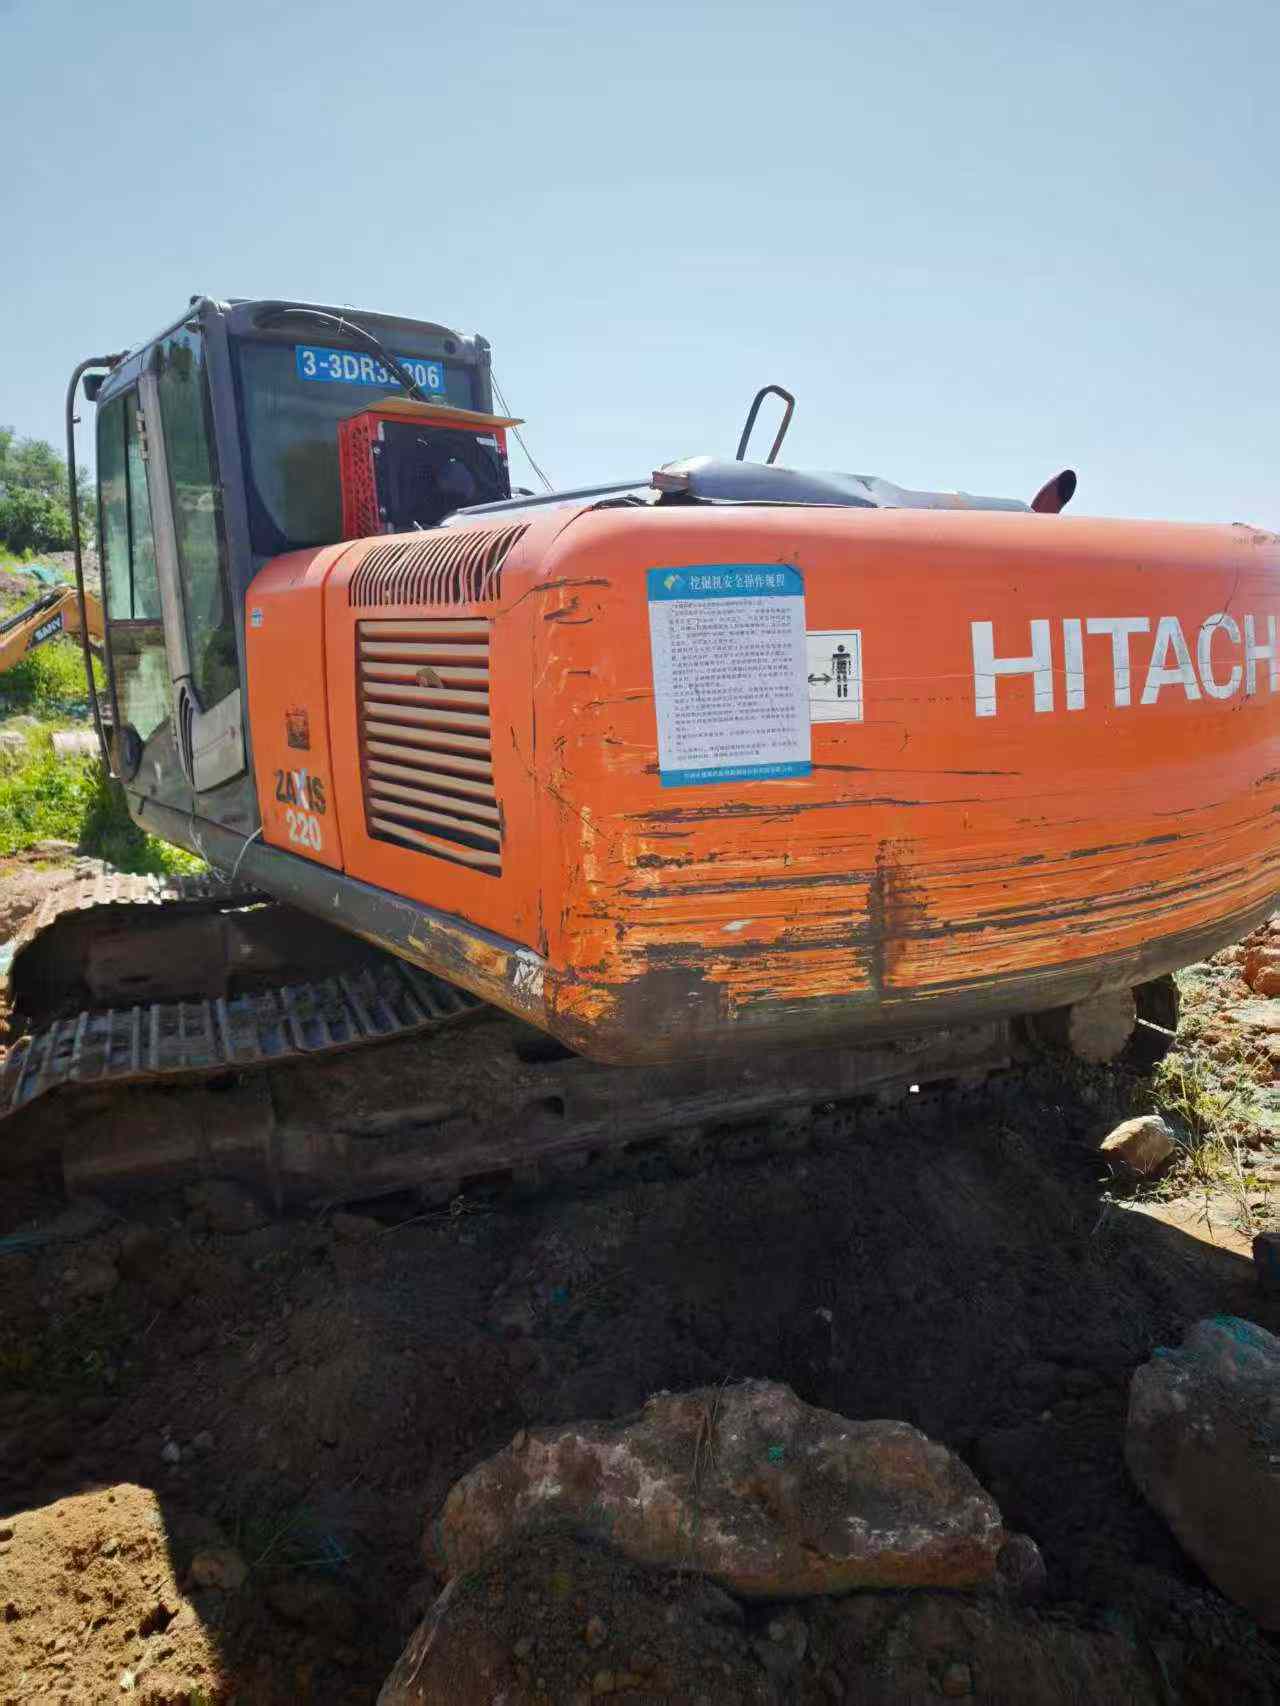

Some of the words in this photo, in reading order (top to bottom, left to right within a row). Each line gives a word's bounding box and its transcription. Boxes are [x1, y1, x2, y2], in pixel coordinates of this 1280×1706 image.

[302, 350, 439, 388] 3-3DR3306
[970, 612, 1280, 717] HITACH
[286, 807, 321, 852] 220
